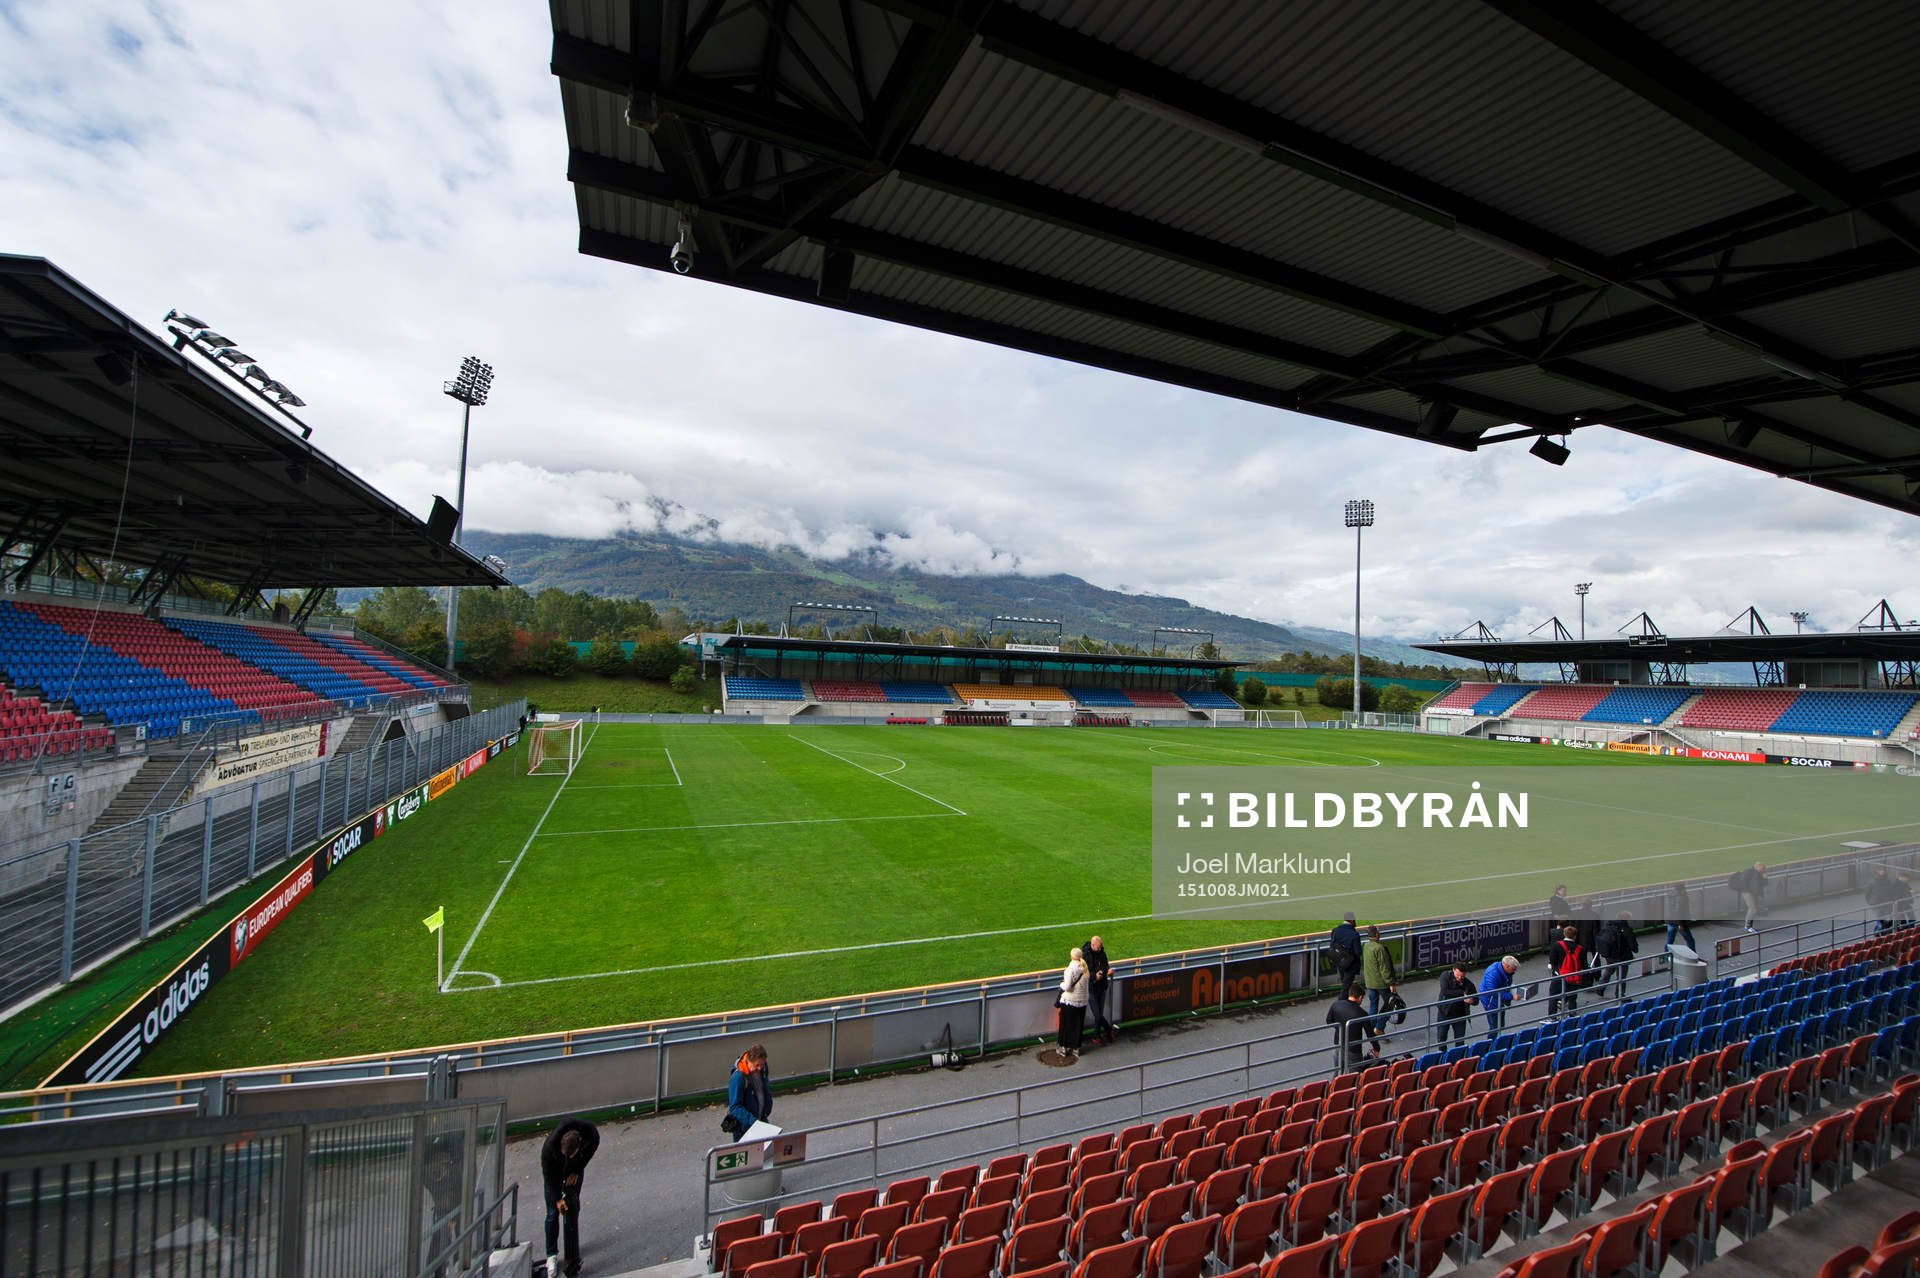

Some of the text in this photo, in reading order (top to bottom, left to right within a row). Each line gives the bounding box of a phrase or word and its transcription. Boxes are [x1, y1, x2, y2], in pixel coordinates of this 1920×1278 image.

[1509, 735, 1531, 744] adidas
[1609, 743, 1651, 752] Continental
[1701, 750, 1750, 761] KONAMI
[1791, 757, 1832, 768] SOCAR
[217, 762, 258, 780] ADVOCATUR
[397, 790, 420, 820] Carlsberg
[333, 826, 362, 865] SOCAR
[249, 868, 313, 938] EUROPEAN QUALIFIERS
[1444, 920, 1524, 945] BUCHBINDEREI
[1133, 988, 1181, 1004] Konditorei
[1192, 968, 1284, 1008] Amann
[143, 962, 209, 1044] adidas
